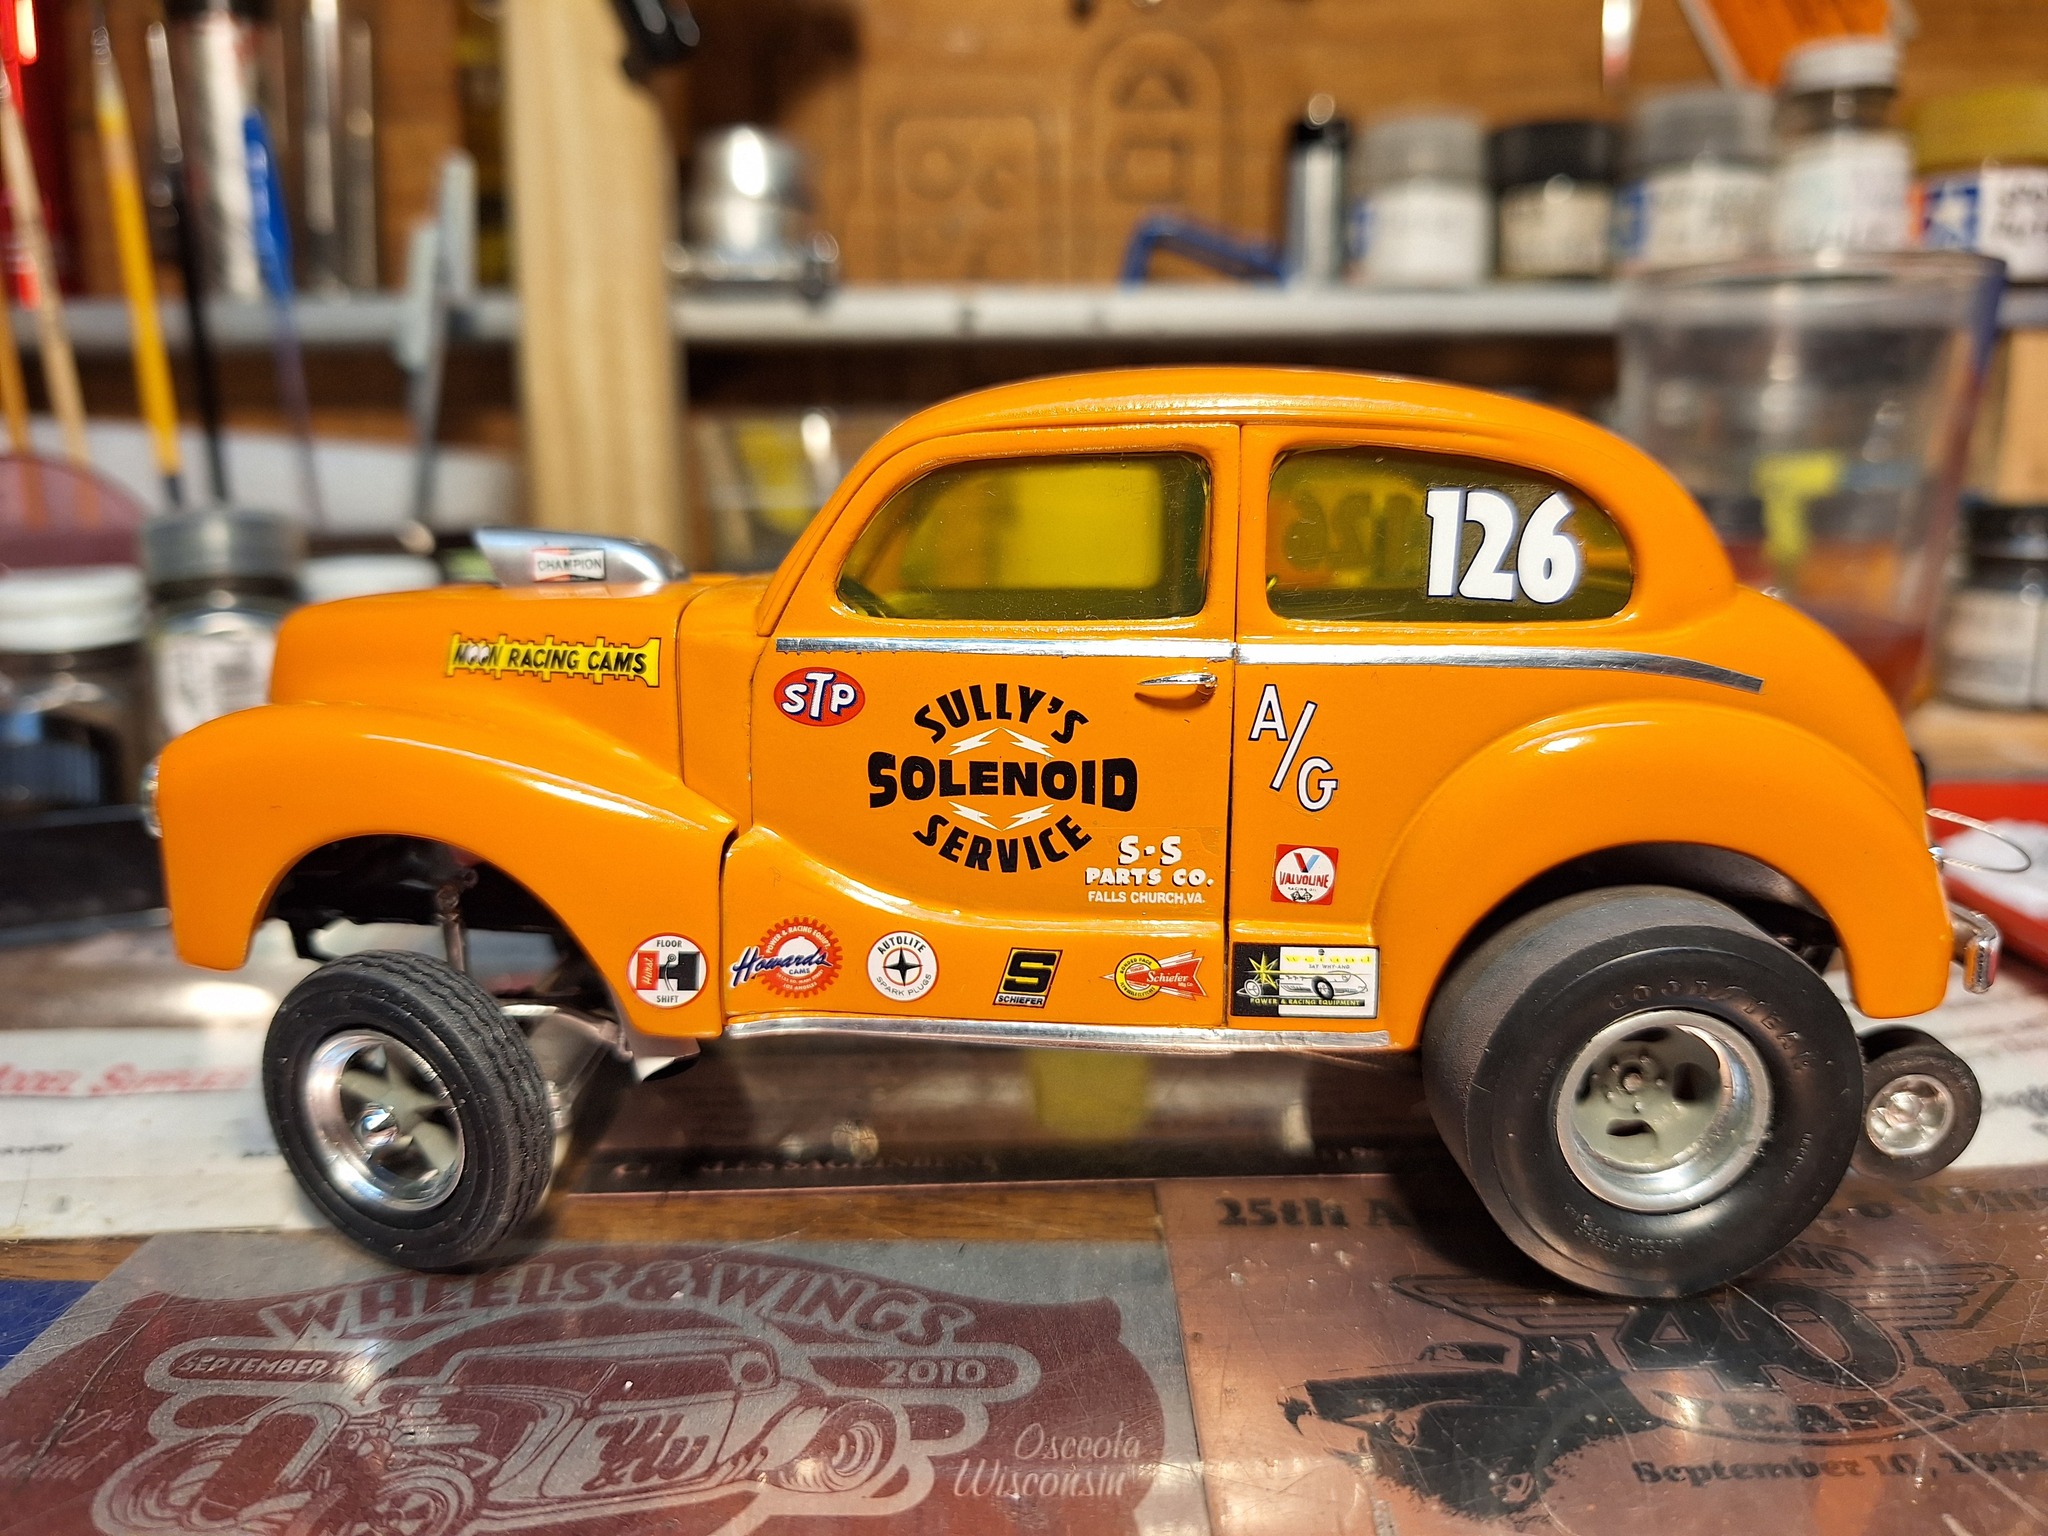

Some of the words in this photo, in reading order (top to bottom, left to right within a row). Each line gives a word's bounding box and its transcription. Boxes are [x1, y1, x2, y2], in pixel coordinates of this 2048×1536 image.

[1425, 489, 1582, 605] 126
[537, 558, 602, 571] CHAMPION
[454, 643, 502, 667] MOON
[508, 646, 580, 670] RACING
[587, 650, 648, 674] CAMS
[781, 671, 857, 720] STP
[913, 683, 1089, 744] SULLY'S
[867, 751, 1138, 812] SOLENOID
[913, 814, 1093, 873] SERVICE
[1085, 867, 1162, 886] PARTS
[1172, 868, 1214, 887] CO.
[1279, 871, 1329, 889] VALVOLINE
[1088, 890, 1126, 903] FALLS
[656, 939, 683, 947] FLOOR
[765, 933, 783, 954] POWER
[787, 925, 813, 934] RACING
[877, 936, 927, 955] AUTOLITE
[876, 976, 905, 996] SPARK
[907, 973, 932, 996] PLUGS
[1146, 971, 1189, 982] Schiefer
[656, 995, 679, 1003] SHIFT
[998, 995, 1043, 1005] SCHIEFER
[1216, 1196, 1350, 1227] 25th
[709, 1262, 977, 1347] WINGS
[178, 1354, 329, 1376] SEPTEMBER
[880, 1358, 987, 1385] 2010
[1015, 1421, 1141, 1460] Osceola
[954, 1458, 1127, 1497] Wisconsin
[1632, 1456, 1864, 1487] September
